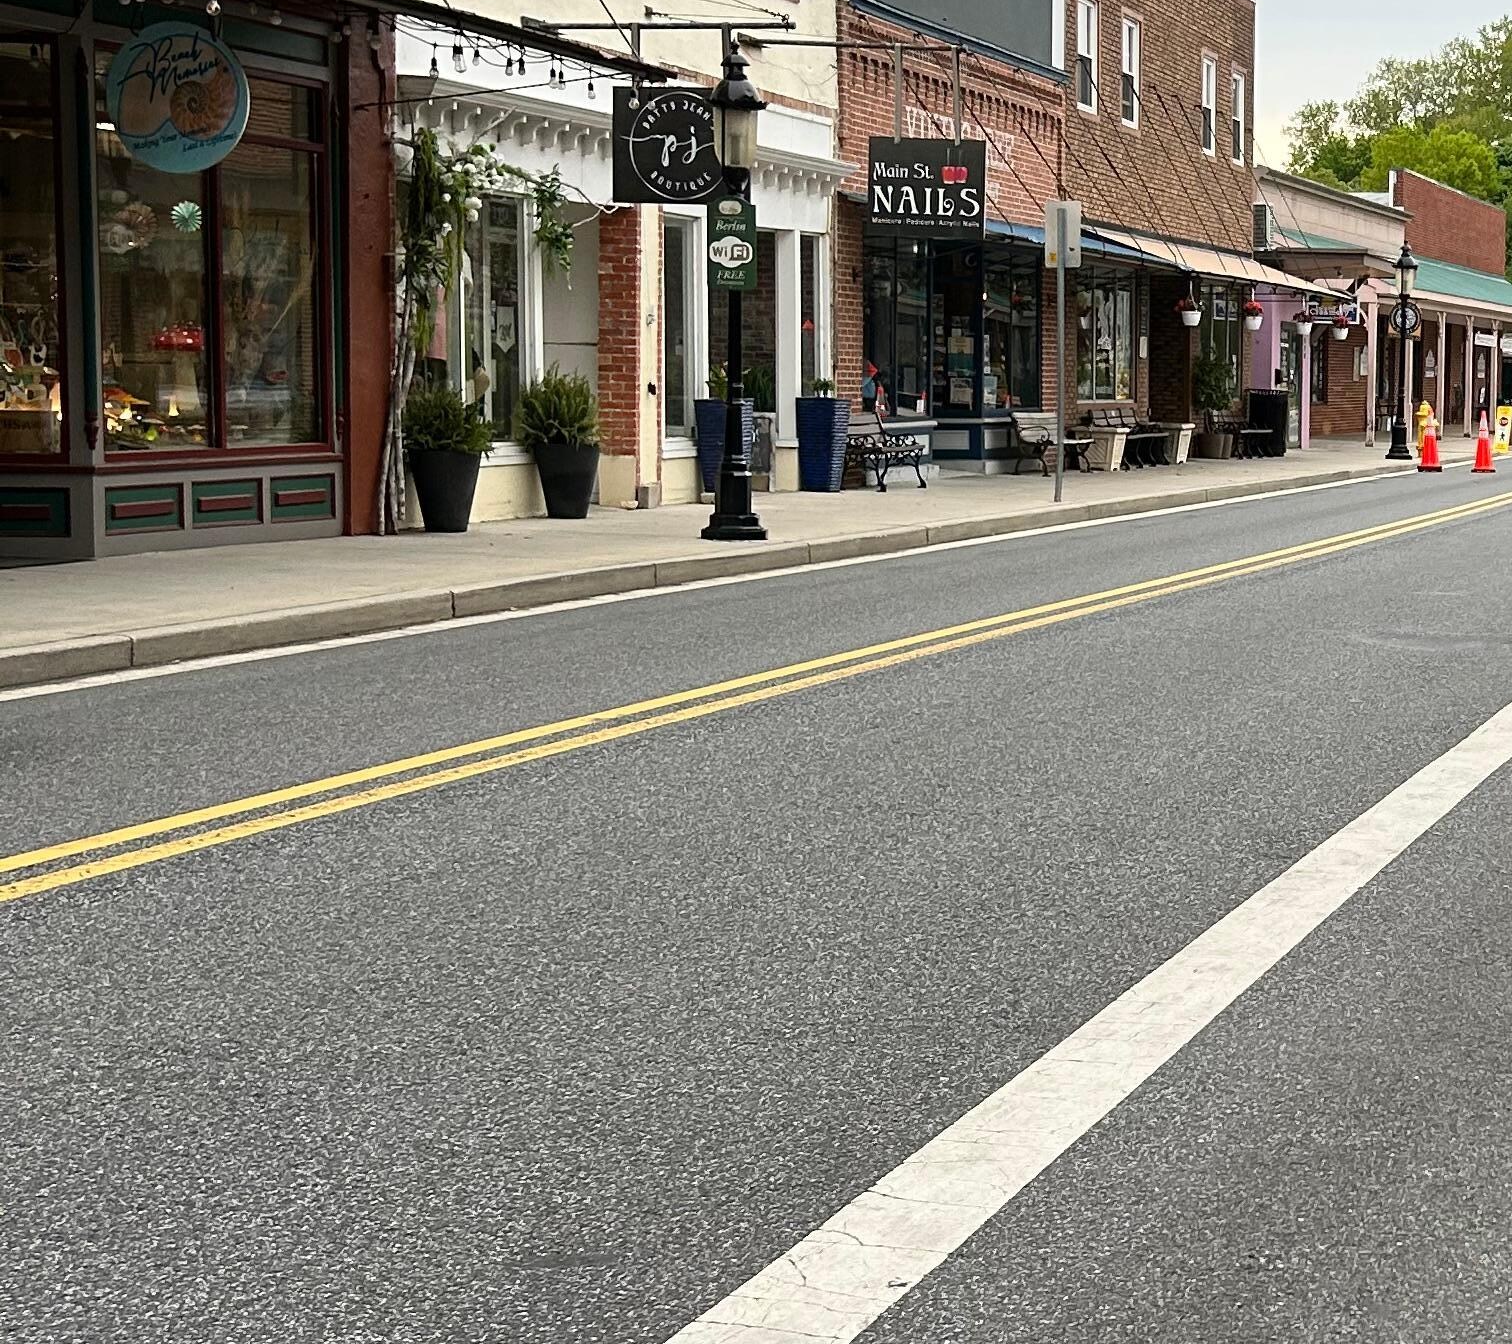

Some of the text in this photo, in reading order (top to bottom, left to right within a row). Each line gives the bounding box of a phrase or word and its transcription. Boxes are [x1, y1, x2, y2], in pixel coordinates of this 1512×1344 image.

[642, 101, 677, 130] PATTY
[650, 170, 712, 192] BOUTIQUE
[873, 162, 935, 181] Main St.
[873, 185, 980, 217] NAILS
[715, 220, 747, 231] Berlin
[717, 270, 746, 280] FREE
